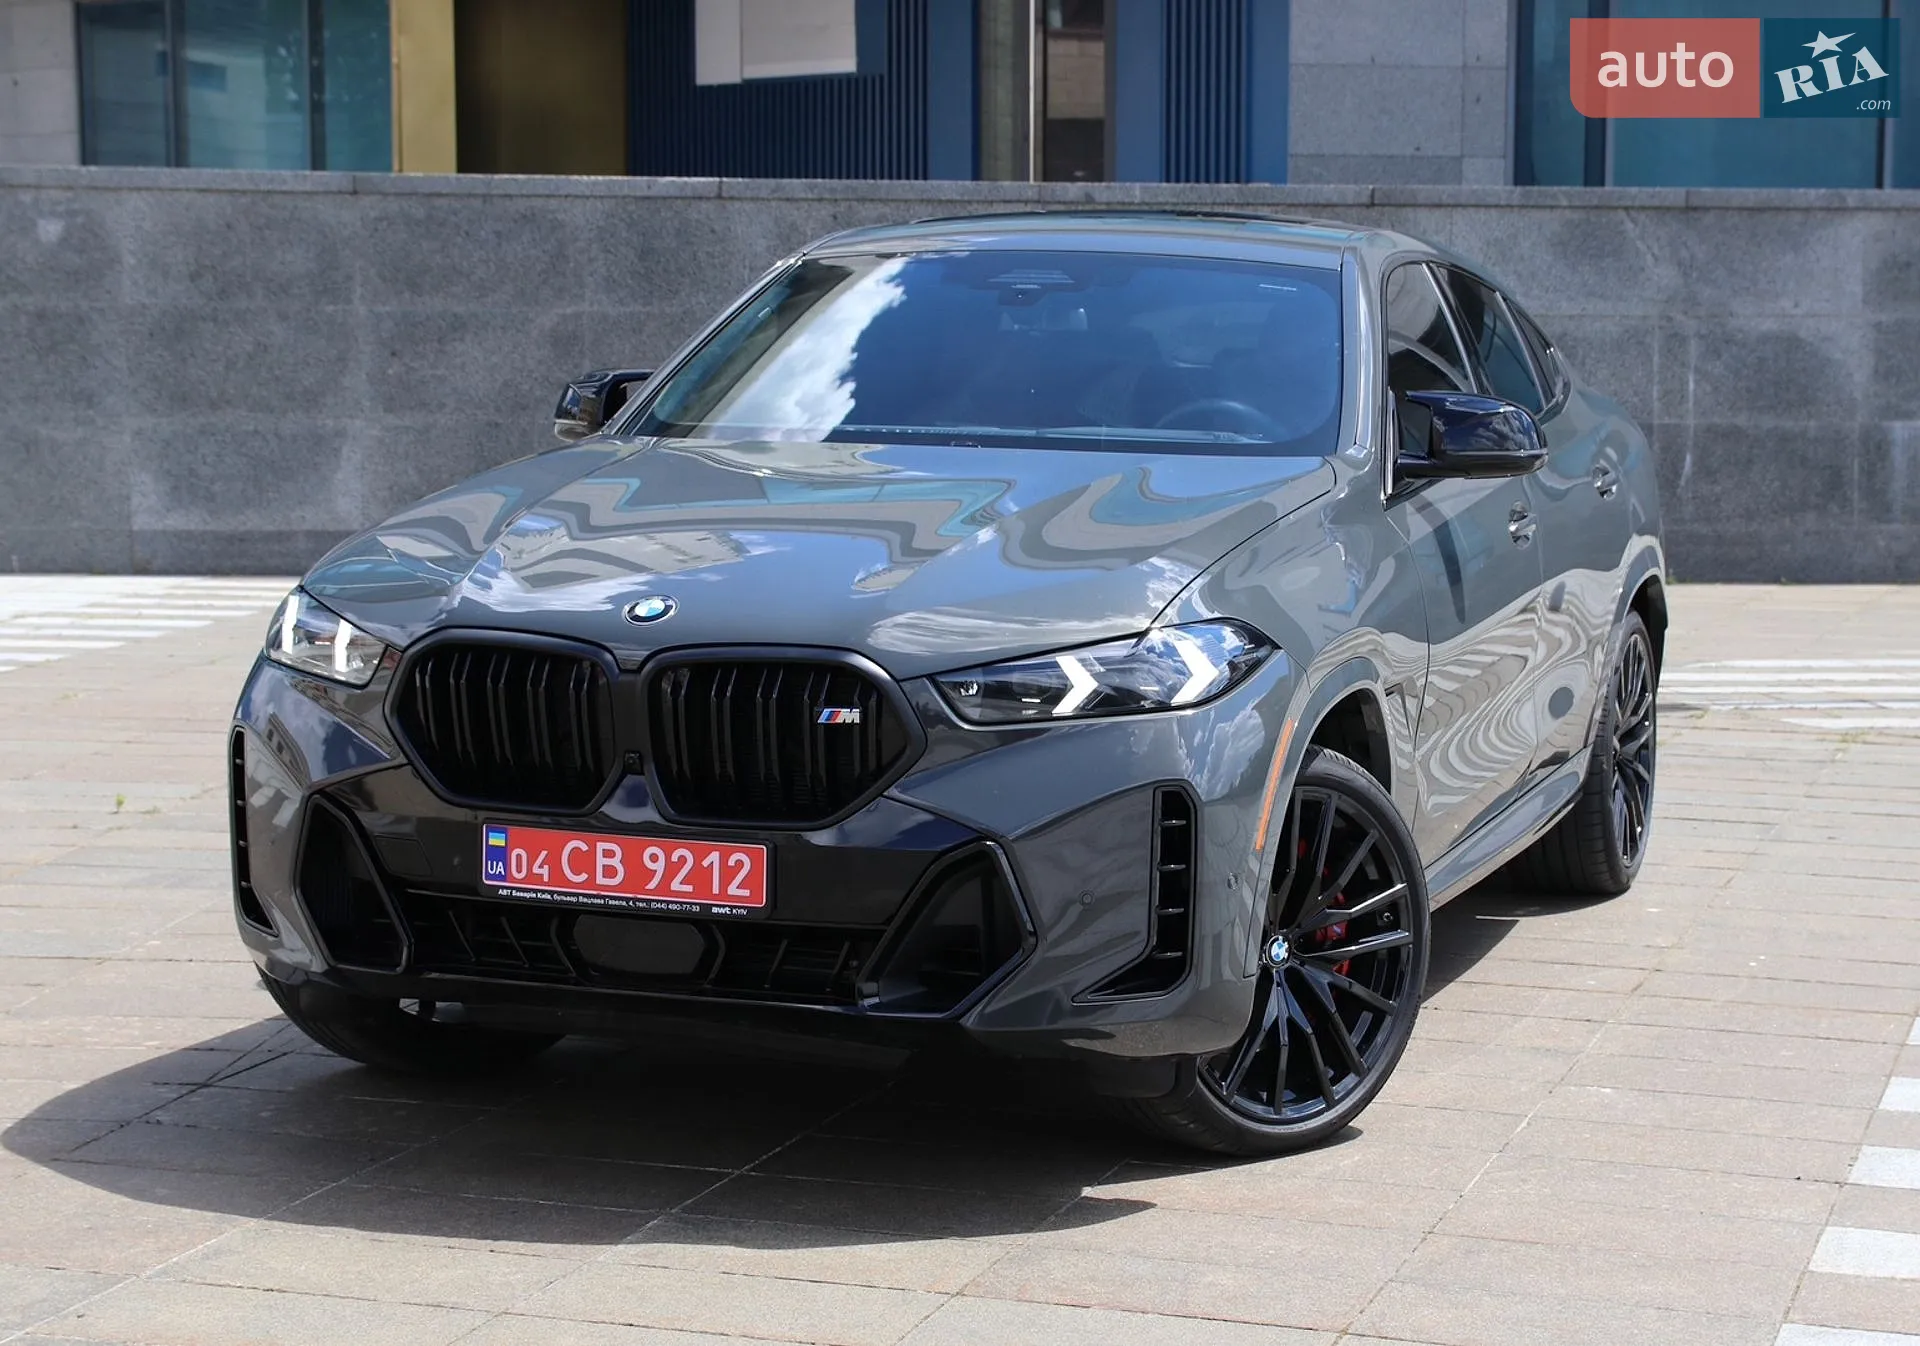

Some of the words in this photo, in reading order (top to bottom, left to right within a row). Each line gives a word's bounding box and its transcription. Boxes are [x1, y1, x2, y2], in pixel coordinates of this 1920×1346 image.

[488, 859, 505, 876] UA
[510, 848, 550, 882] 04
[561, 839, 626, 886] CB
[642, 846, 752, 897] 9212
